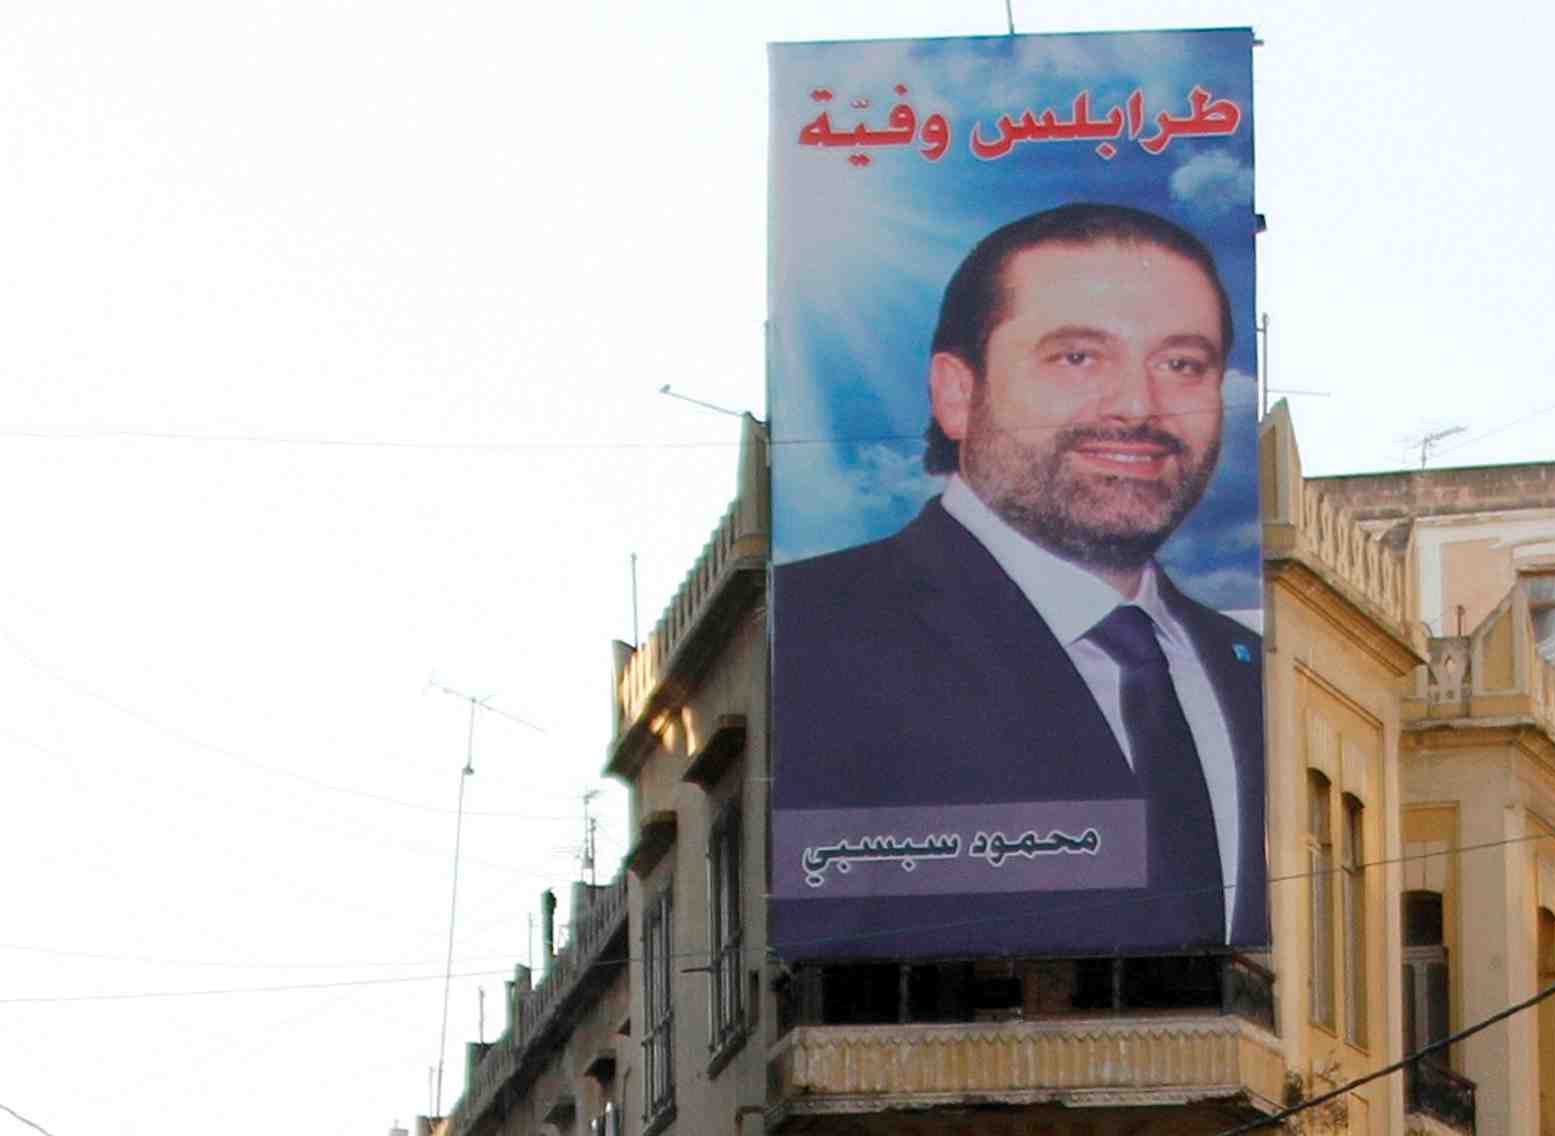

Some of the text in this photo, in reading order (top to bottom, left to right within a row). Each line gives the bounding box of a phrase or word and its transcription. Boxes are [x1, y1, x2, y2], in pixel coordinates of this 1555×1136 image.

[970, 87, 1242, 161] طرابلس
[802, 827, 1100, 888] محمود سبسبي
